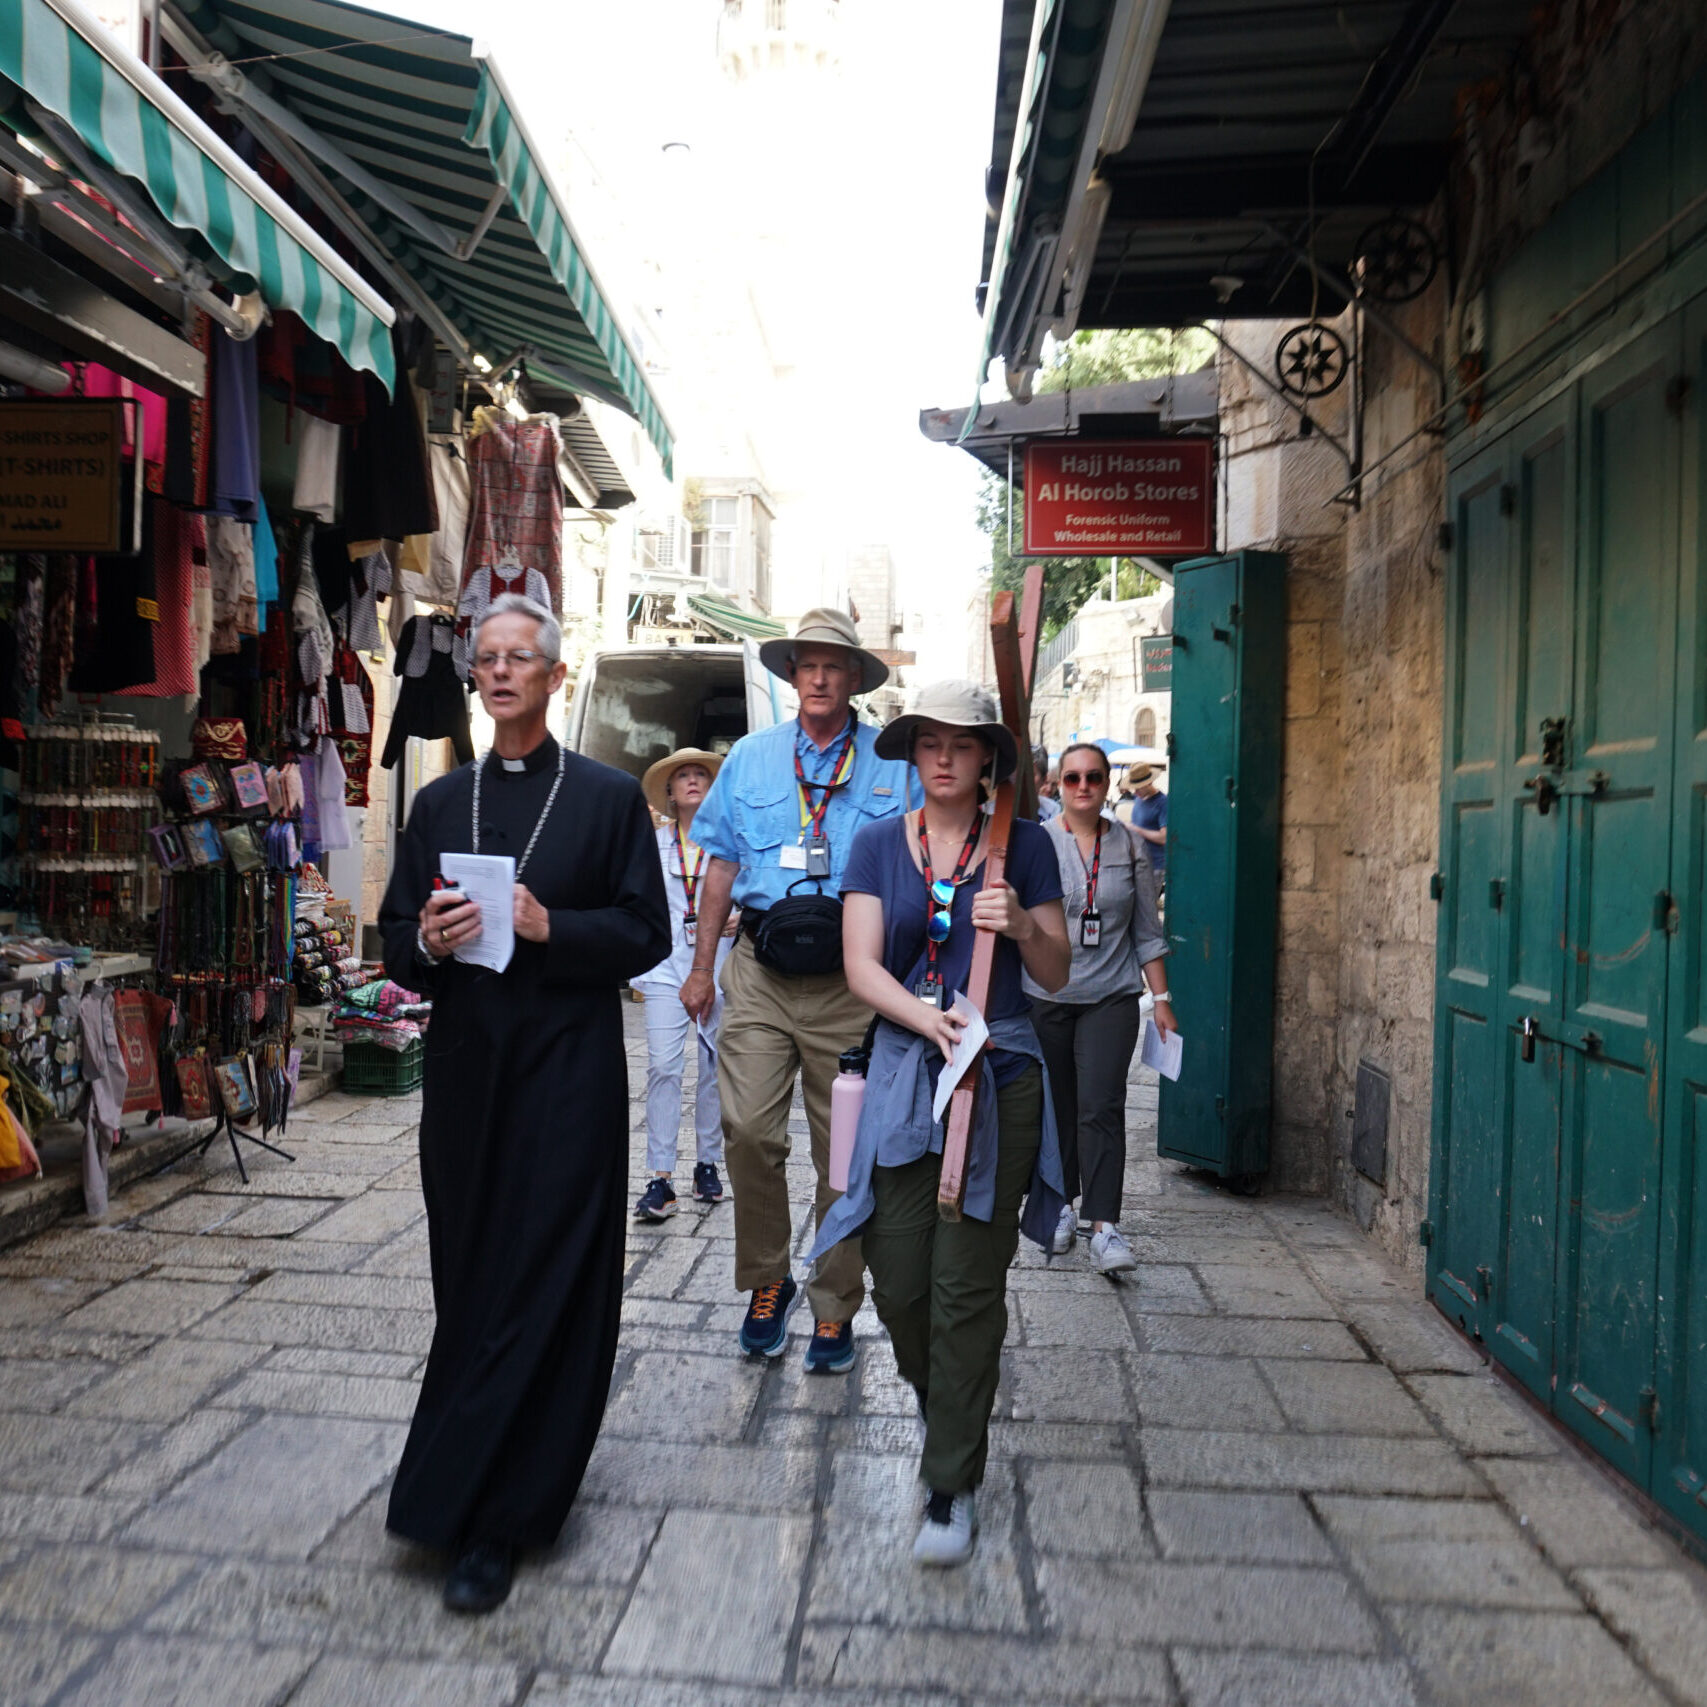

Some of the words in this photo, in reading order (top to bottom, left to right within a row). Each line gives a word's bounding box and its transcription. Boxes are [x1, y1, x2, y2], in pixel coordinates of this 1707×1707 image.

[65, 431, 109, 446] SHOP
[1061, 455, 1102, 477] Hajj
[1107, 455, 1181, 473] Hassan
[1038, 482, 1060, 501] Al
[1064, 482, 1129, 501] Horob
[1134, 483, 1199, 500] Stores
[41, 494, 67, 509] ALI
[1065, 513, 1117, 526] Forensic
[1120, 513, 1171, 526] Uniform
[1054, 529, 1116, 542] Wholesale
[1119, 529, 1143, 542] and
[1146, 529, 1181, 542] Retail
